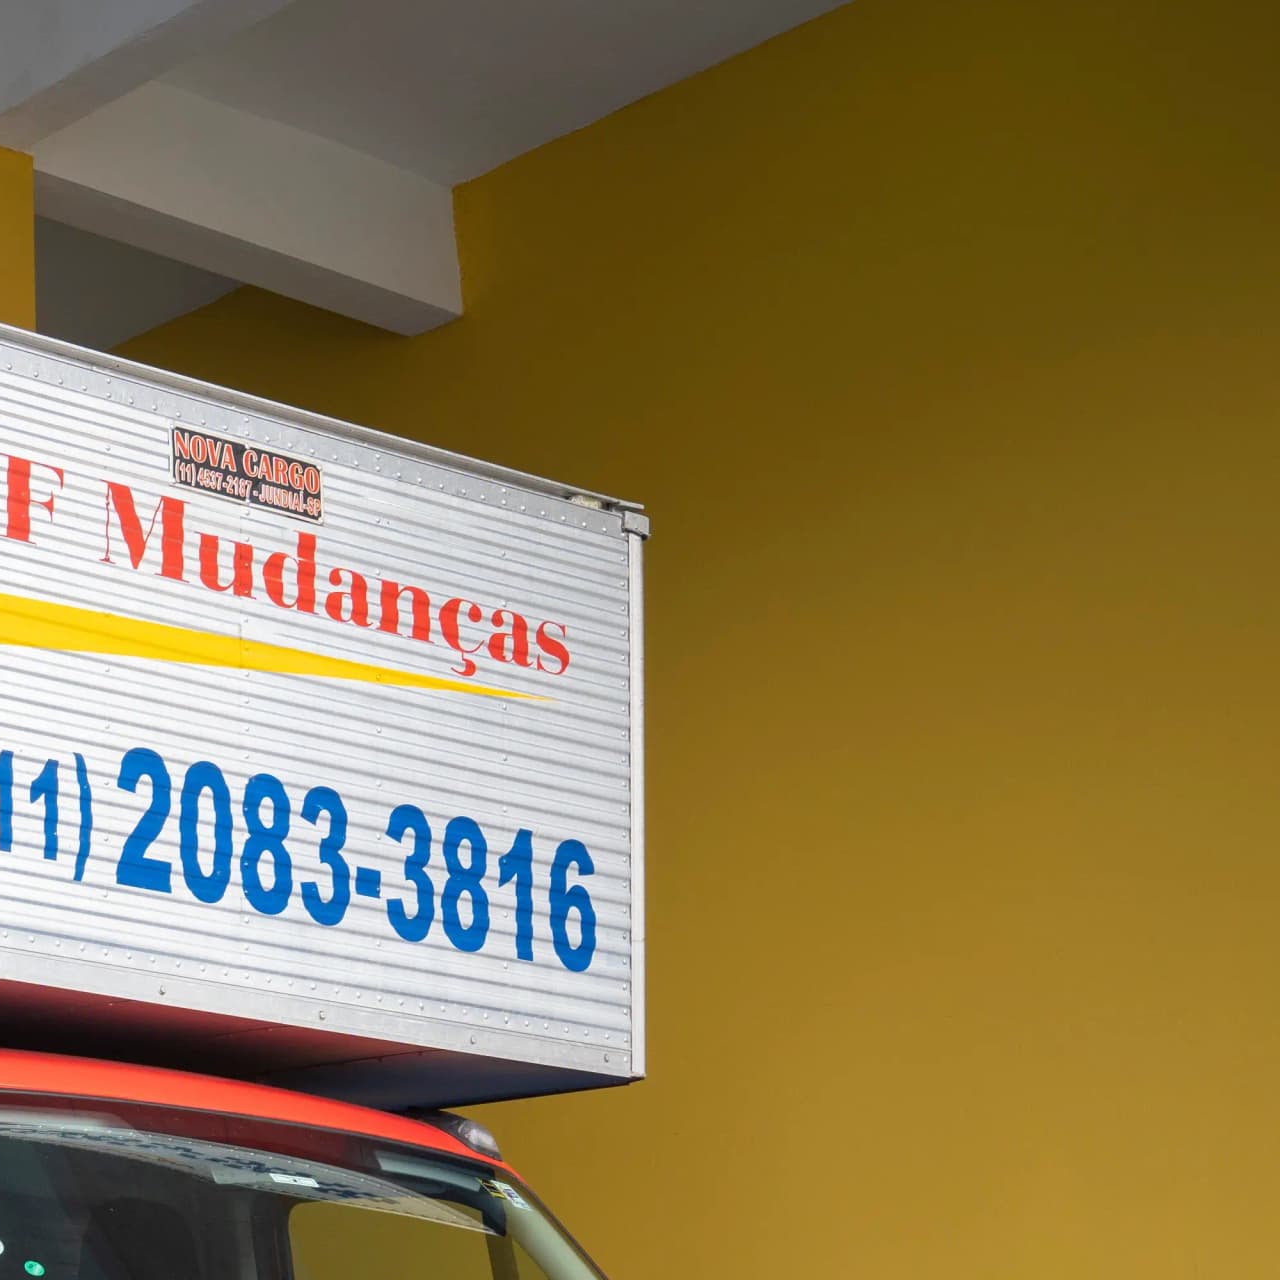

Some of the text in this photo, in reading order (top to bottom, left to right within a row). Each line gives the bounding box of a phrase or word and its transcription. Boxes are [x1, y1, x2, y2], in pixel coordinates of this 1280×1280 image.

[173, 430, 321, 495] NOVA CARGO
[99, 479, 573, 677] Mudanças
[116, 746, 597, 973] 2083-3816
